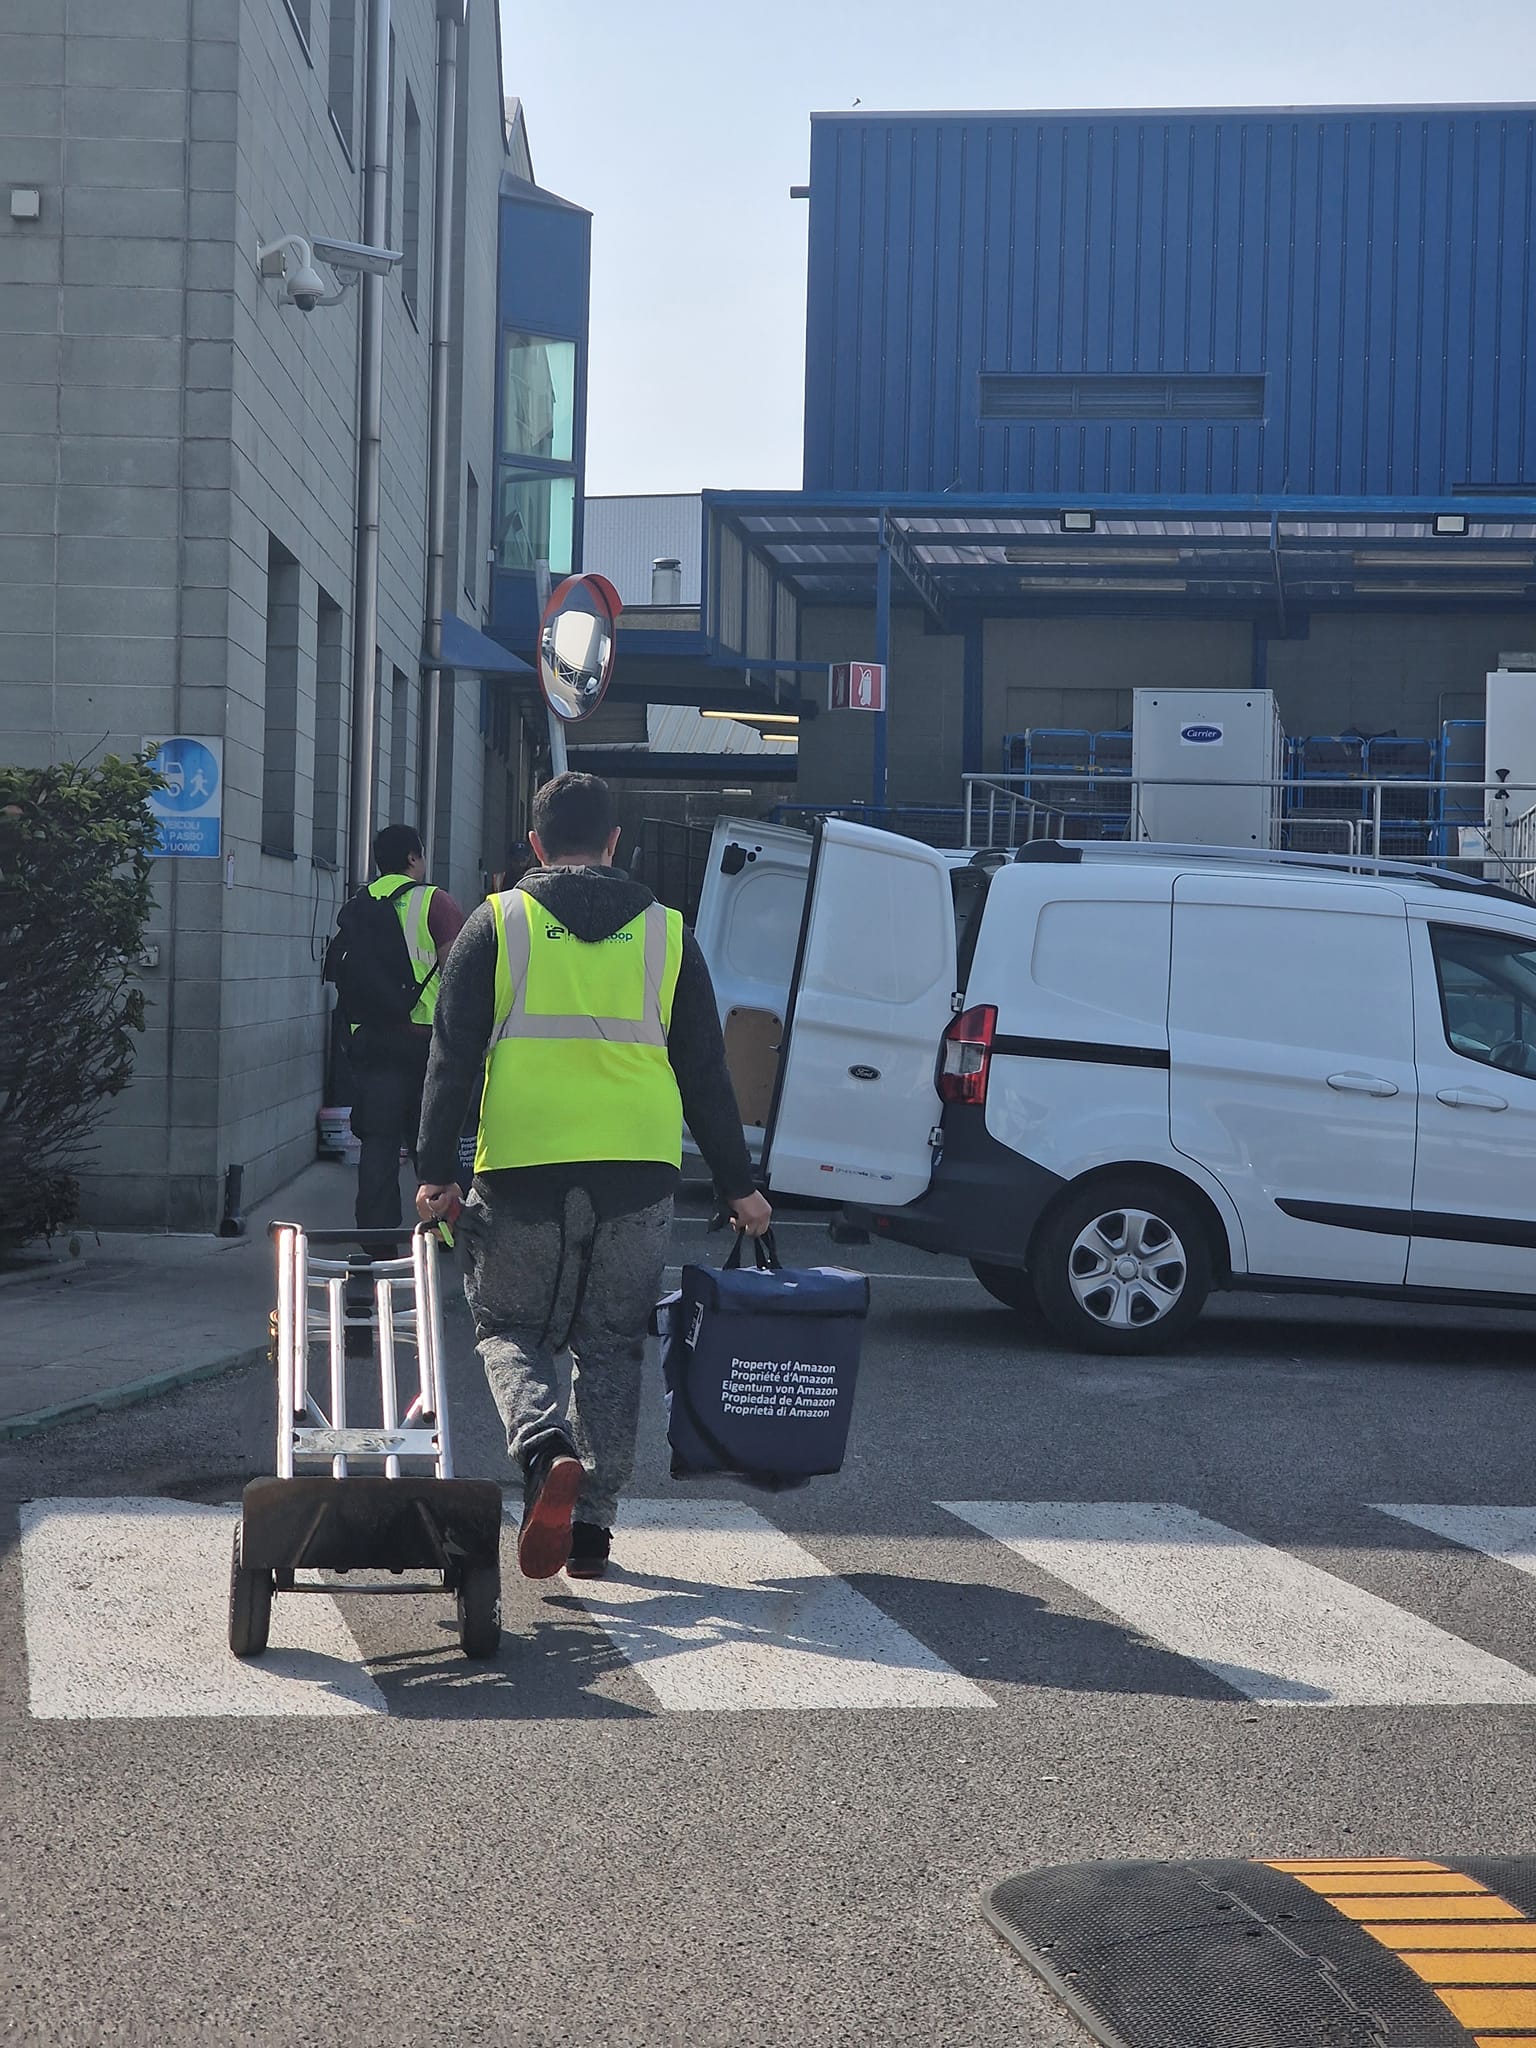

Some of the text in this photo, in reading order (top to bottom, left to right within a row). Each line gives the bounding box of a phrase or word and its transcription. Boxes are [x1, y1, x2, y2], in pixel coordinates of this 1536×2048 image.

[170, 831, 204, 841] PASSO
[731, 1358, 836, 1373] Property of Amazon
[731, 1370, 780, 1382] Propriété
[722, 1380, 772, 1393] Eigentum
[797, 1385, 838, 1396] Amazon
[721, 1392, 836, 1407] Propiedad de Amazon
[724, 1403, 829, 1417] Proprietà di Amazon
